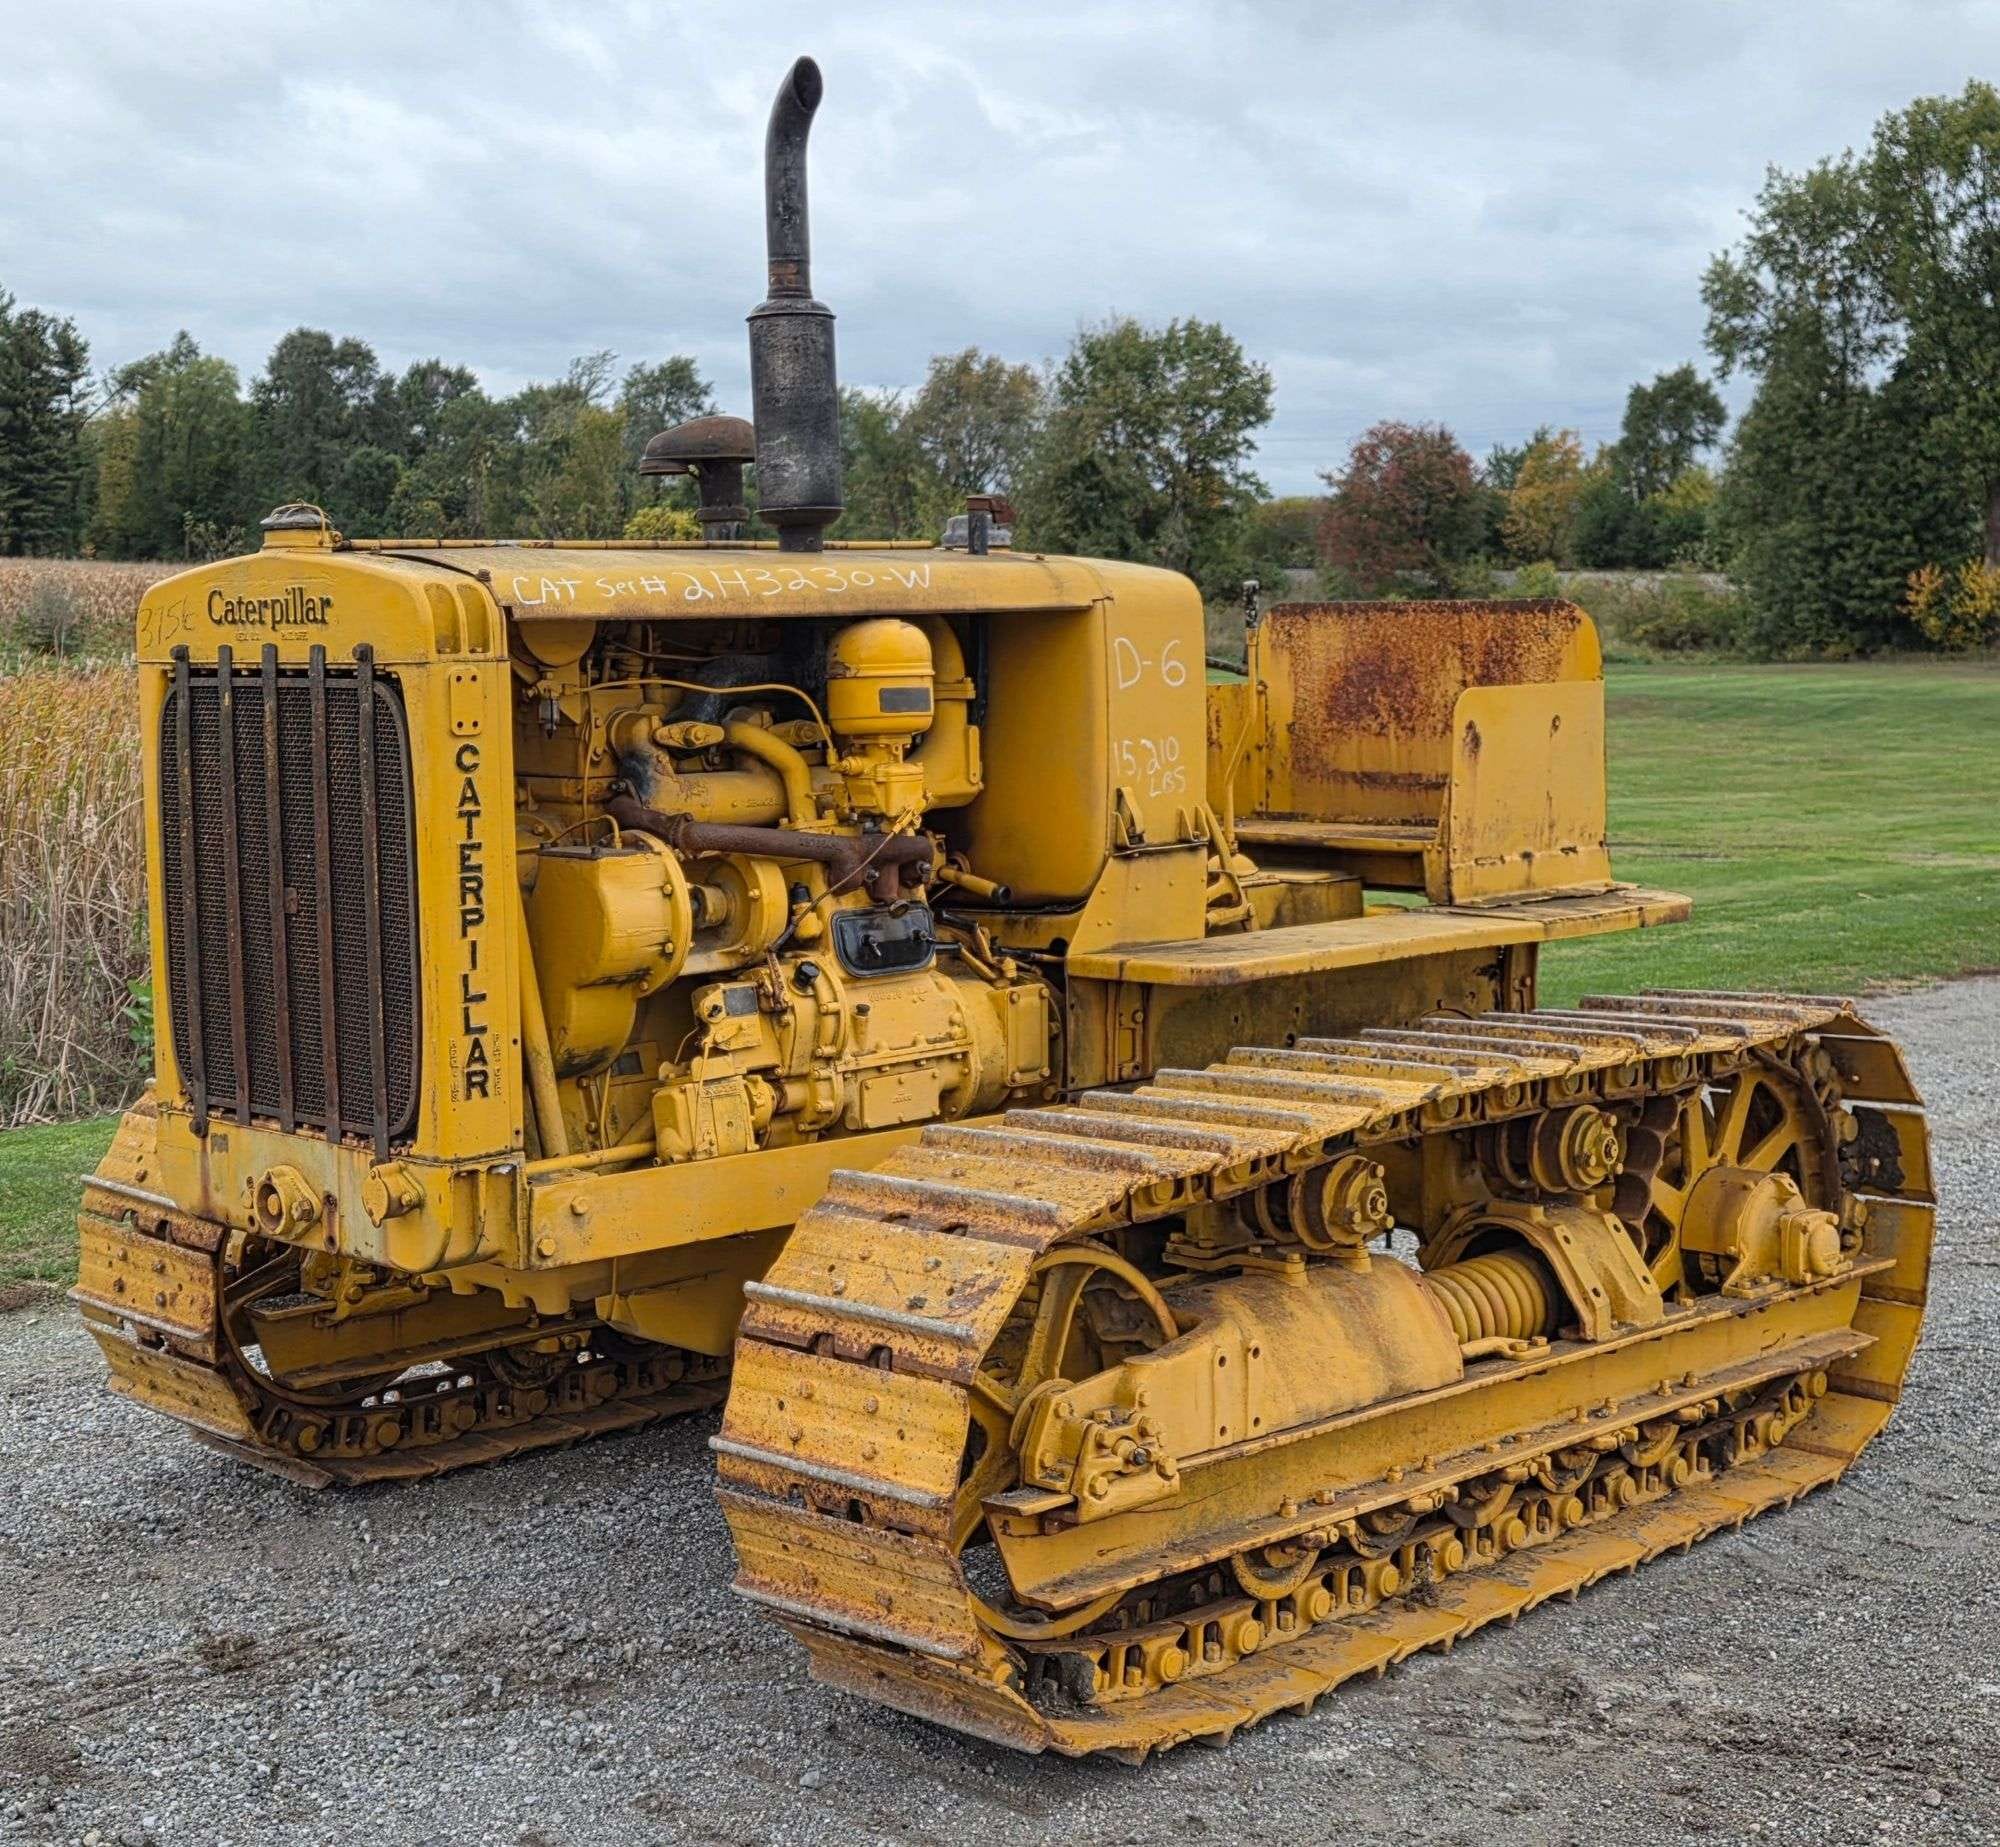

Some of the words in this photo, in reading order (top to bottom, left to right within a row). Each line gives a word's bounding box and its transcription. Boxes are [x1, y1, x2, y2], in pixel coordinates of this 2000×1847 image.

[512, 576, 582, 605] CAT
[672, 564, 931, 602] 2H3230-W
[207, 586, 334, 632] Caterpillar
[1114, 637, 1187, 690] D-6
[1150, 766, 1187, 798] LBS
[455, 742, 490, 1101] CATERPILLAR
